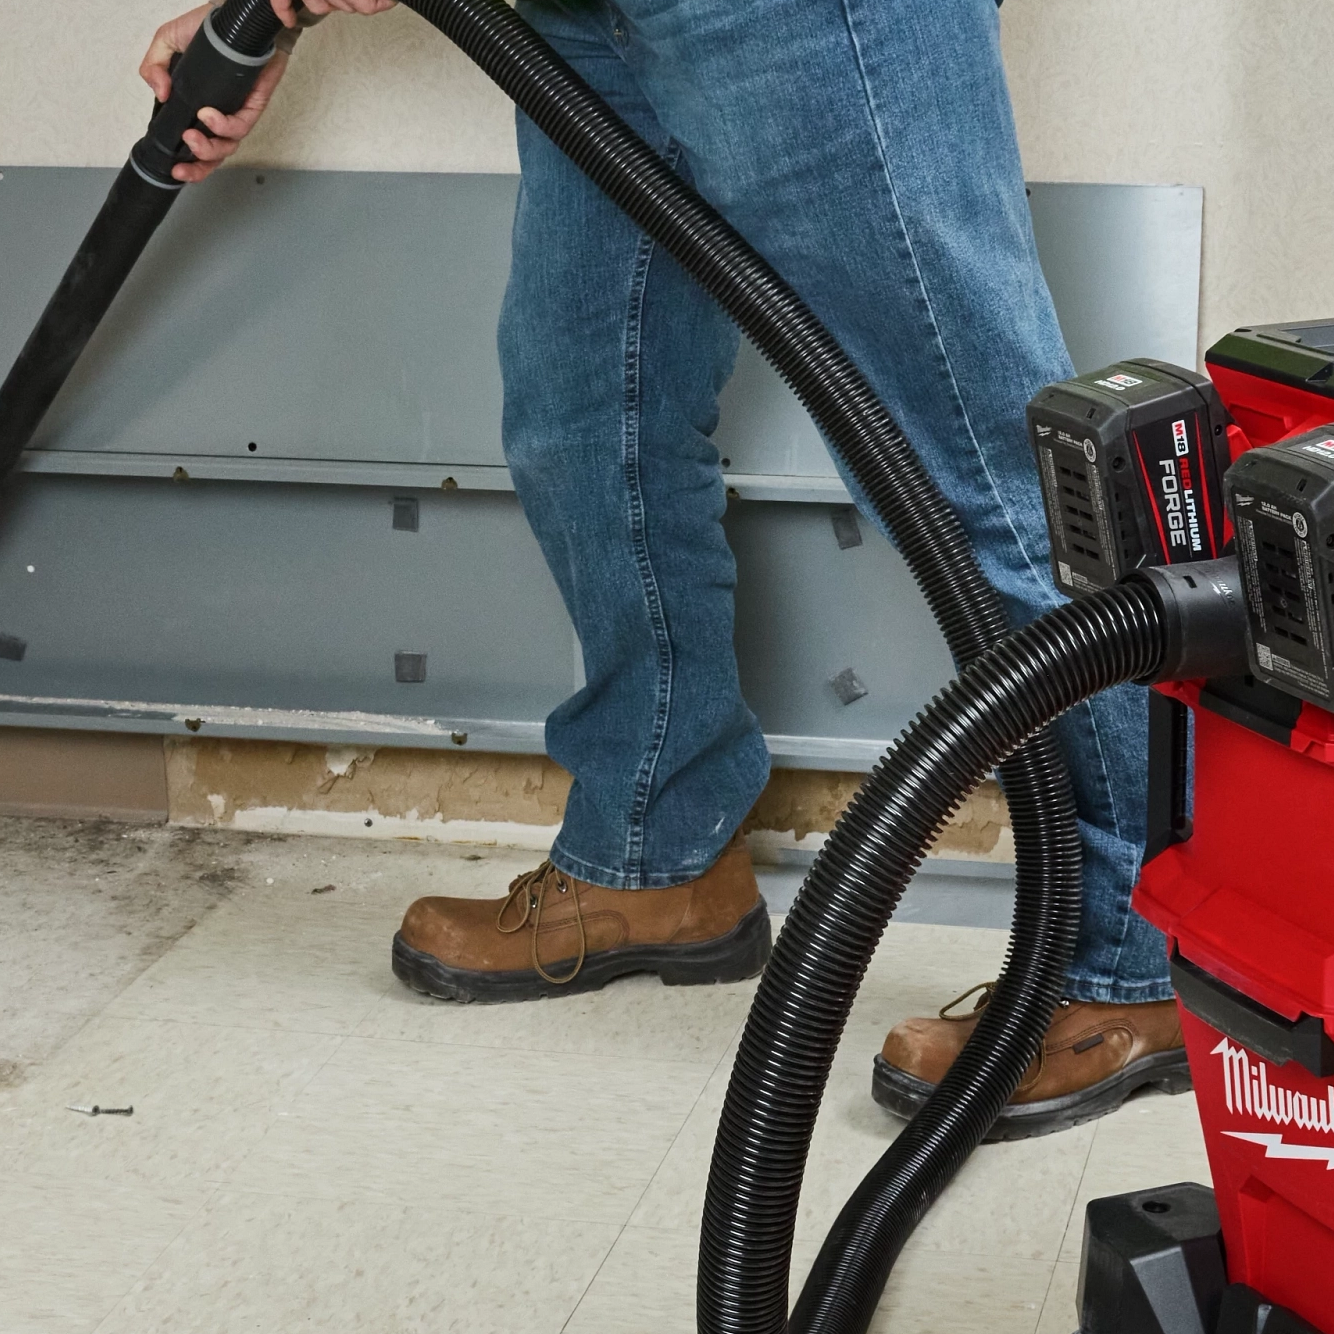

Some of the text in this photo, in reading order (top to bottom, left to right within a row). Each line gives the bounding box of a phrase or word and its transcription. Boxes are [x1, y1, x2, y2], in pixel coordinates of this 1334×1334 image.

[1159, 459, 1187, 548] FORGE
[1174, 423, 1203, 552] M18 REDLITHIUM
